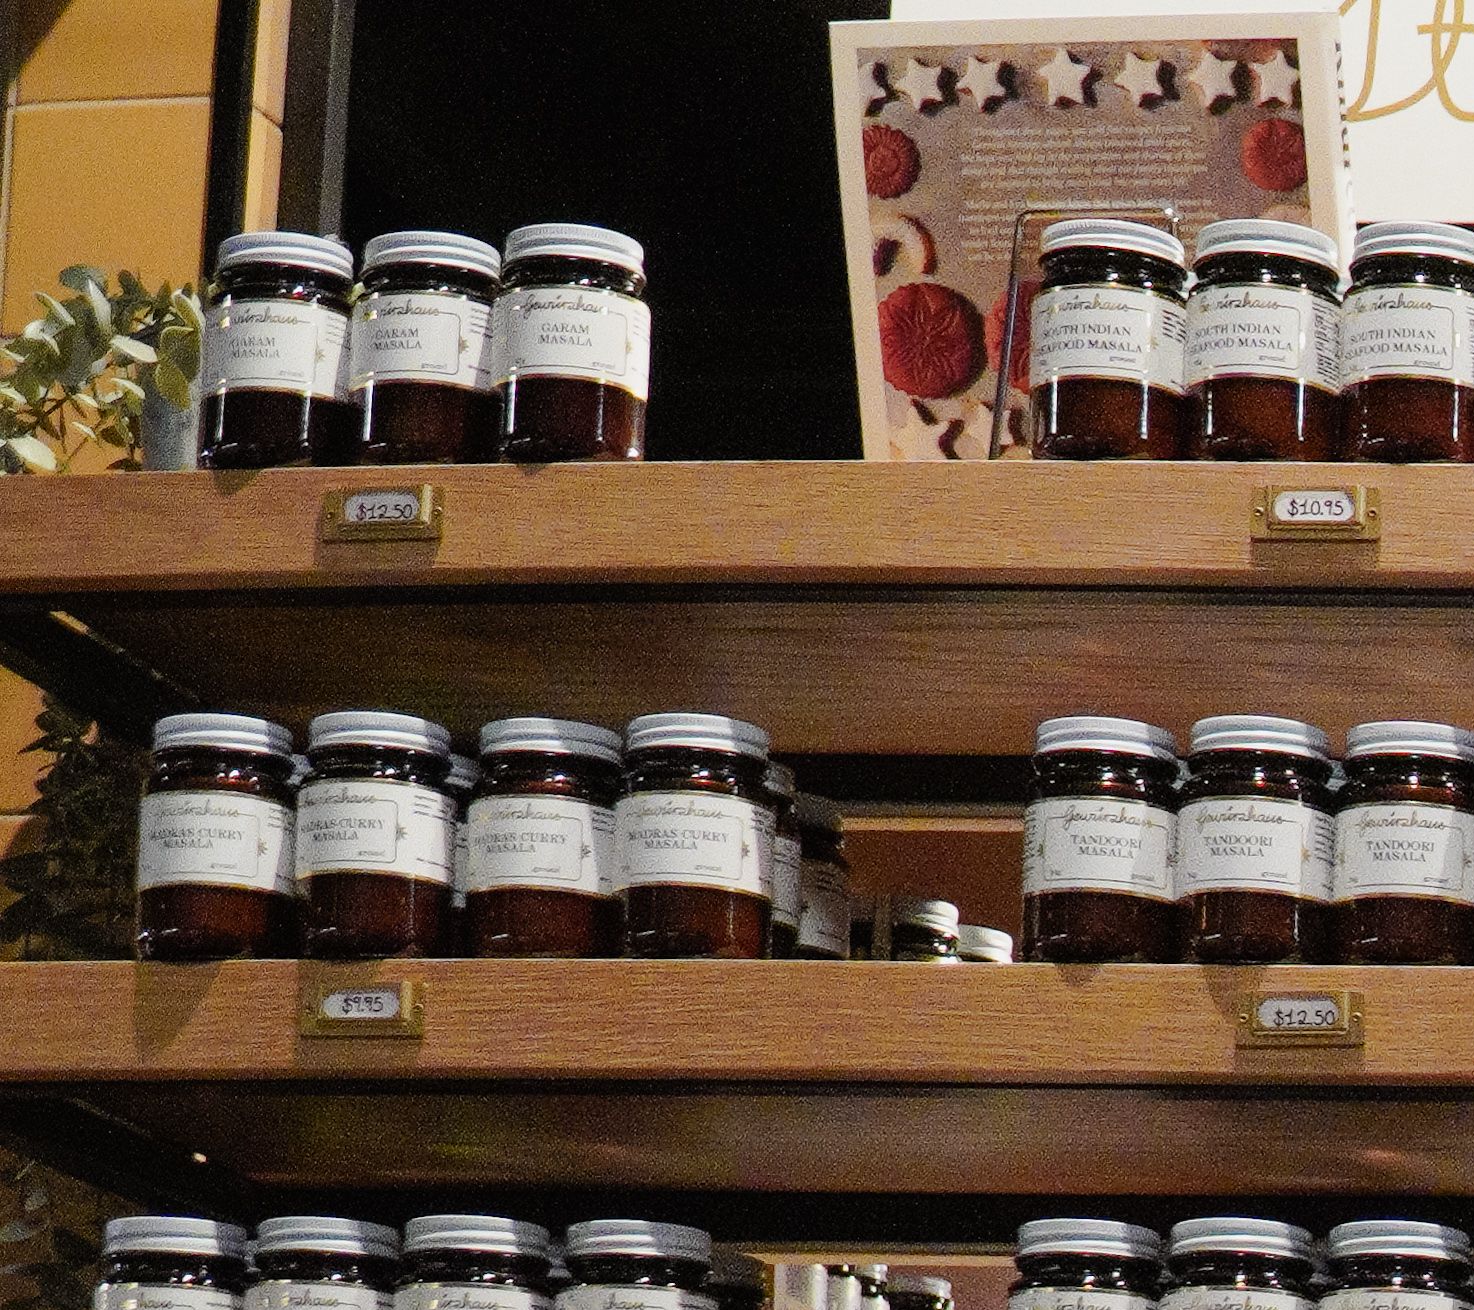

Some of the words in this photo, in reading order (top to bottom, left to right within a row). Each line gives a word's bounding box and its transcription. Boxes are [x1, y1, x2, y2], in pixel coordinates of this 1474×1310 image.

[541, 322, 590, 335] GARAM
[537, 334, 593, 347] MASALA
[1286, 499, 1345, 517] $10.95
[627, 827, 678, 842] MADRAS
[680, 829, 729, 843] CURRY
[1203, 834, 1274, 849] TANDOORI
[643, 838, 698, 851] MASALA
[1210, 846, 1266, 858] MASALA
[341, 996, 384, 1015] $9.95
